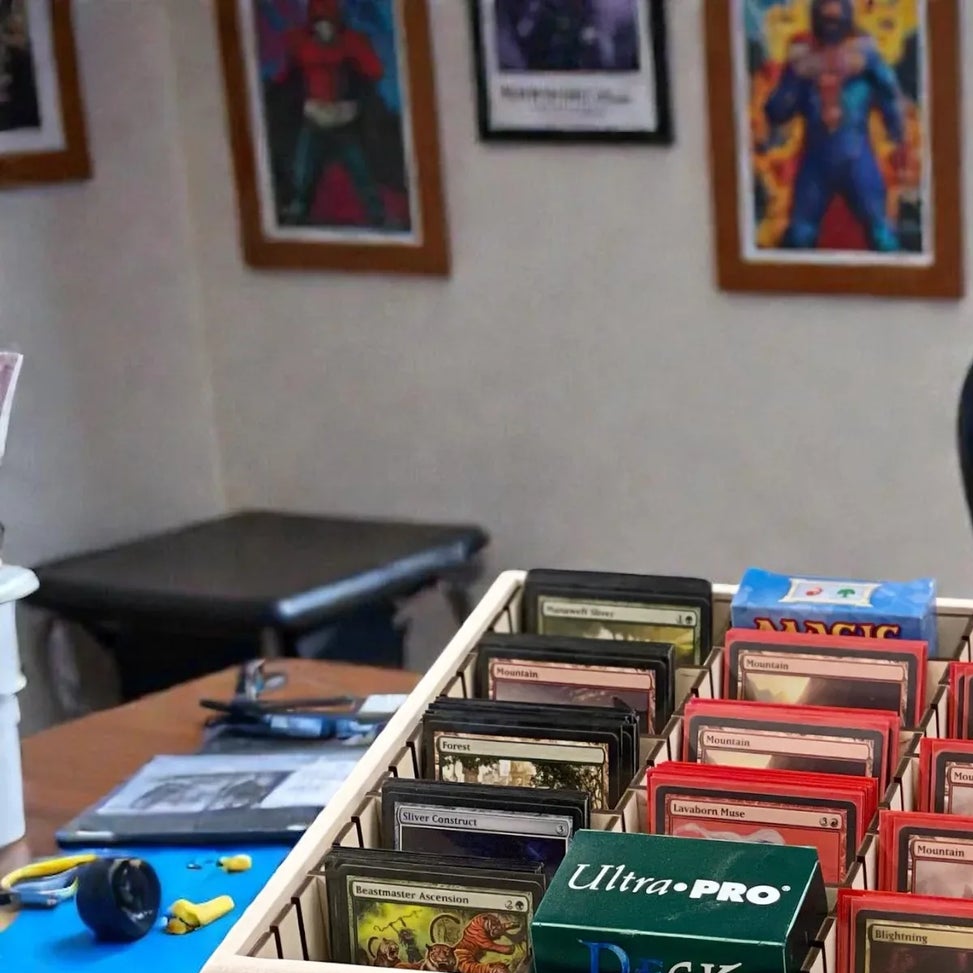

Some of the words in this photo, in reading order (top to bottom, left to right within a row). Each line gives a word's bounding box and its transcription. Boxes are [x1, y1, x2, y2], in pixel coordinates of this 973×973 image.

[747, 659, 789, 670] Mountain
[496, 667, 538, 679] Mountain
[442, 741, 470, 751] Forest
[706, 735, 750, 747] Mountain
[673, 805, 718, 816] Lavaborn
[721, 808, 746, 818] Muse
[402, 813, 429, 823] Sliver
[432, 814, 477, 826] Construct
[917, 845, 965, 857] Mountain
[355, 885, 416, 900] Beastmaster
[419, 891, 469, 904] Ascension
[875, 929, 928, 944] Blightning
